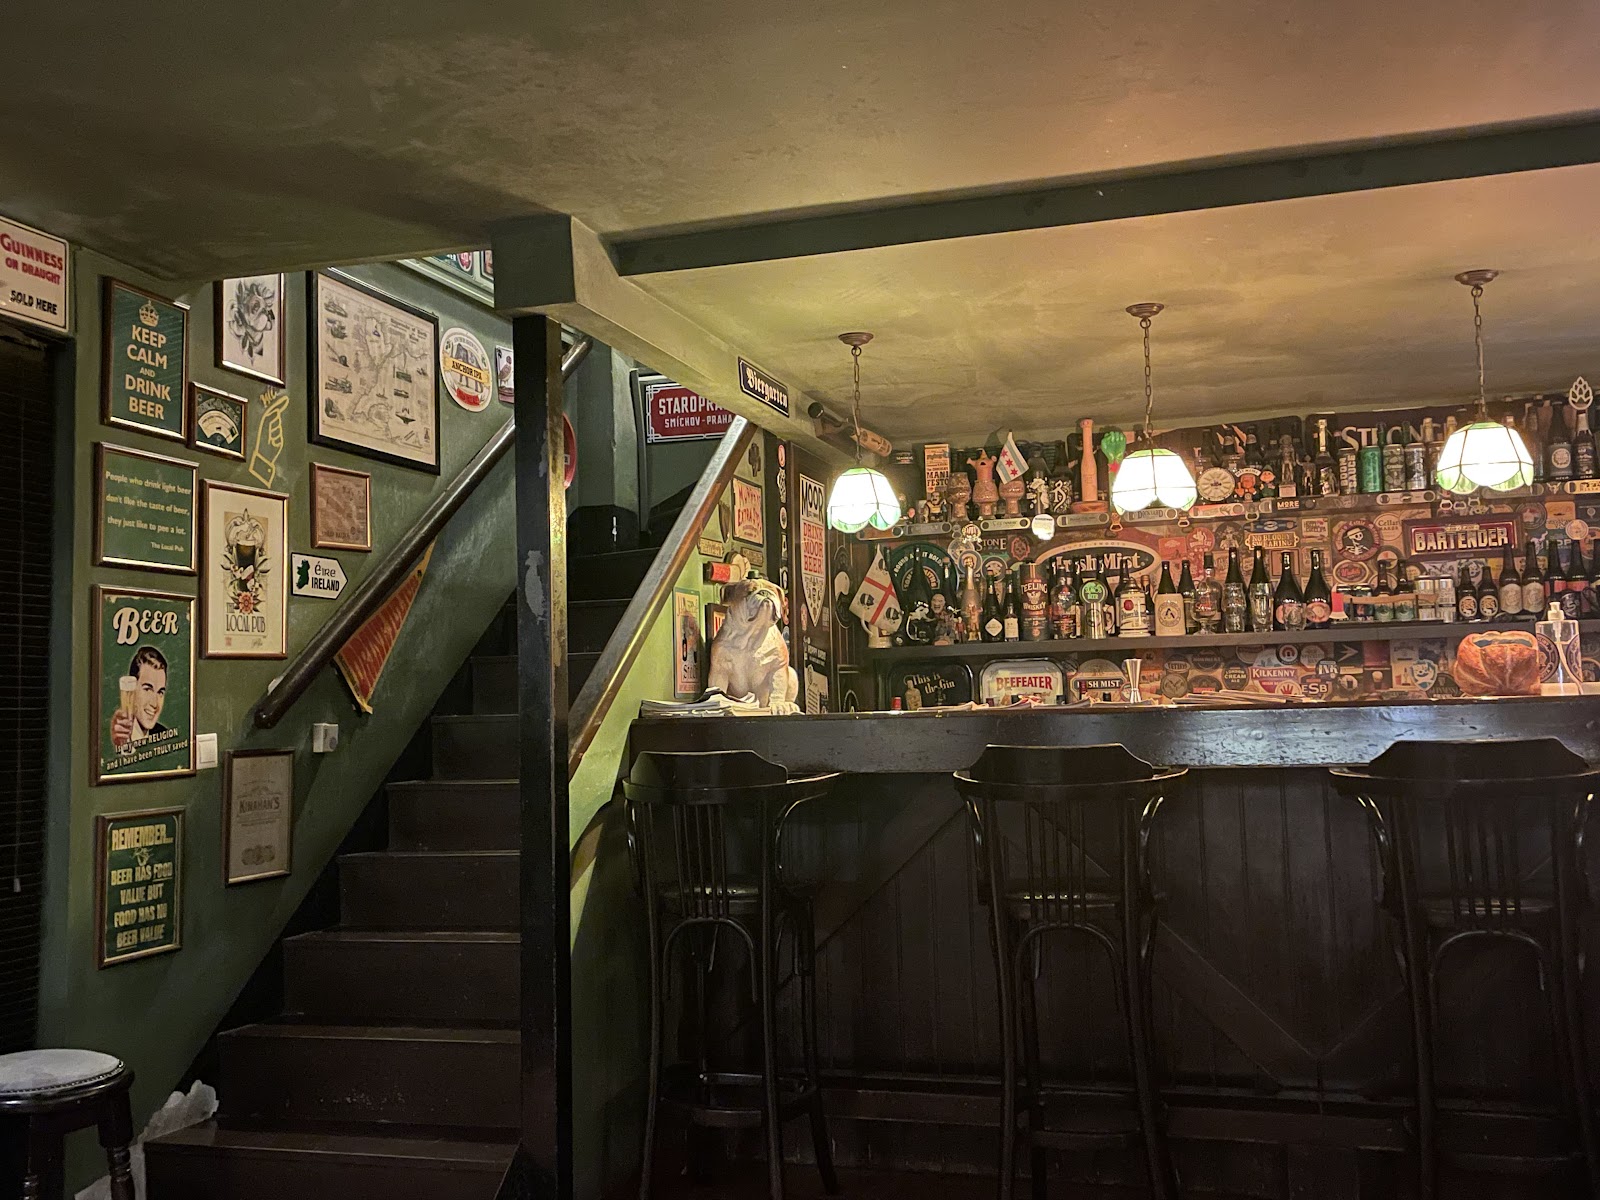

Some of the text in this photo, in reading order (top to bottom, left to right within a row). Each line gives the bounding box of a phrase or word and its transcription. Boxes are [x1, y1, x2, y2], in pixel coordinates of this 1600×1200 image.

[1, 232, 64, 271] GUINNESS
[5, 257, 61, 285] ON DRAUGHT
[10, 289, 57, 315] SOLD HERE
[131, 324, 167, 348] KEEP
[126, 344, 167, 369] CALM
[139, 366, 155, 378] AND
[451, 360, 483, 380] ANCHOR IPA
[125, 374, 171, 402] DRINK
[746, 367, 788, 409] Biergarten
[129, 396, 164, 420] BEER
[664, 416, 700, 429] SMÍCHOV
[706, 414, 733, 425] PRAHA
[105, 470, 191, 496] People who drink light beer
[926, 470, 949, 479] MANI
[105, 494, 190, 517] don't like the taste of beer,
[802, 480, 824, 524] MOOR
[1277, 500, 1299, 510] MORE
[107, 515, 121, 528] they
[122, 517, 135, 528] just
[136, 519, 148, 530] like
[149, 523, 157, 531] to
[175, 525, 187, 536] lot.
[803, 522, 824, 543] DRINK
[150, 541, 160, 550] The
[160, 543, 174, 551] Local
[803, 537, 824, 559] MOOR
[975, 537, 1007, 552] STONE
[1252, 534, 1262, 542] NO
[1415, 527, 1508, 551] BARTENDER
[803, 555, 824, 574] BEER
[1055, 554, 1098, 573] Irsh
[311, 578, 340, 592] IRELAND
[1021, 583, 1048, 595] TEELING
[1023, 601, 1047, 611] WHISKEY
[112, 606, 179, 646] BEER
[226, 614, 266, 633] LOCAL PUB
[912, 672, 941, 687] This is
[996, 675, 1053, 692] BEEFEATER
[1252, 667, 1296, 679] KILKENNY
[939, 678, 956, 690] Gin
[1100, 680, 1120, 688] MIST
[1301, 682, 1328, 694] ESB
[148, 728, 179, 745] RELIGION
[106, 759, 118, 771] and
[122, 755, 138, 767] have
[138, 751, 153, 762] been
[153, 744, 172, 756] TRULY
[172, 739, 189, 751] saved
[111, 824, 174, 851] REMEMBER...
[111, 862, 173, 886] BEER HAS FOOD
[120, 883, 165, 906] VALUE BUT
[114, 910, 137, 928] FOOD
[138, 907, 156, 923] HAS
[116, 924, 165, 949] BEER VALUE
